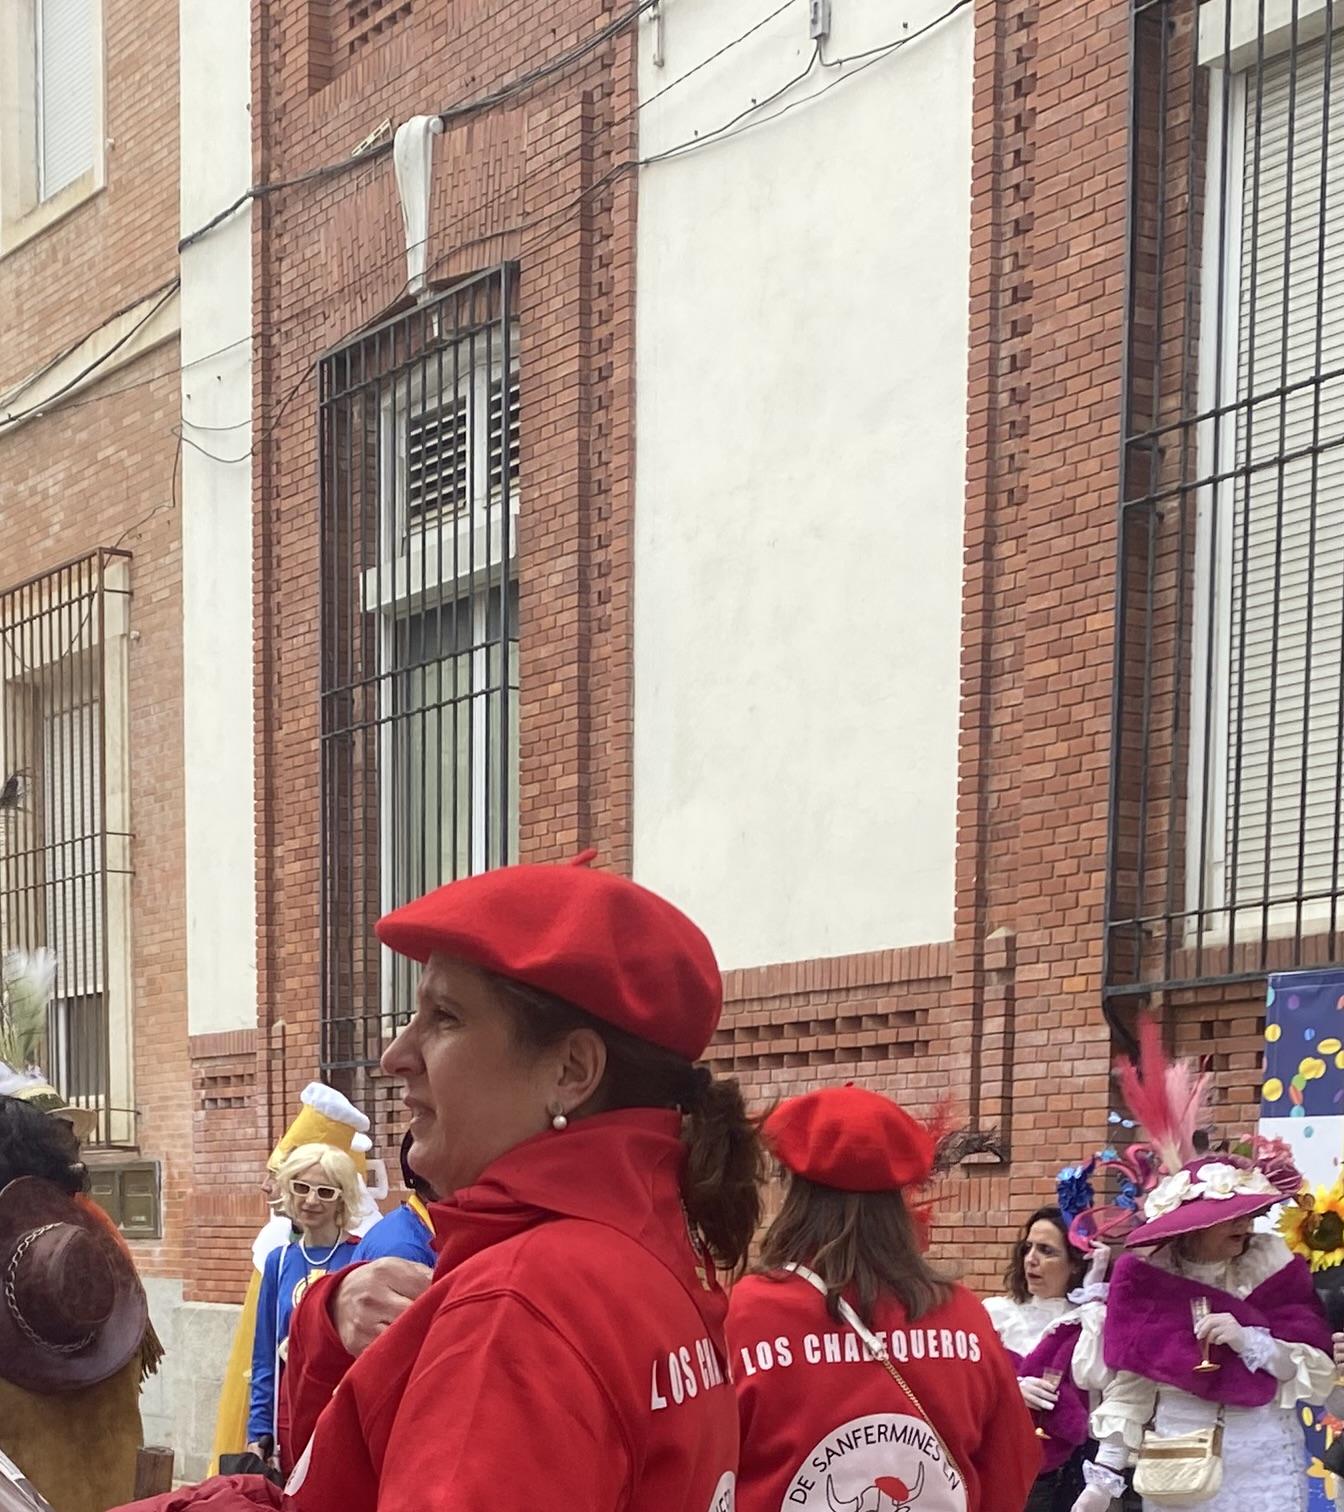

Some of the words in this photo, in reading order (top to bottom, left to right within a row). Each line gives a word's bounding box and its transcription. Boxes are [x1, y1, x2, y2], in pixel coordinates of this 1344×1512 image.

[650, 1345, 698, 1411] LOS
[740, 1336, 793, 1377] LOS
[788, 1475, 817, 1506] DE
[812, 1423, 941, 1473] SANFERMINES
